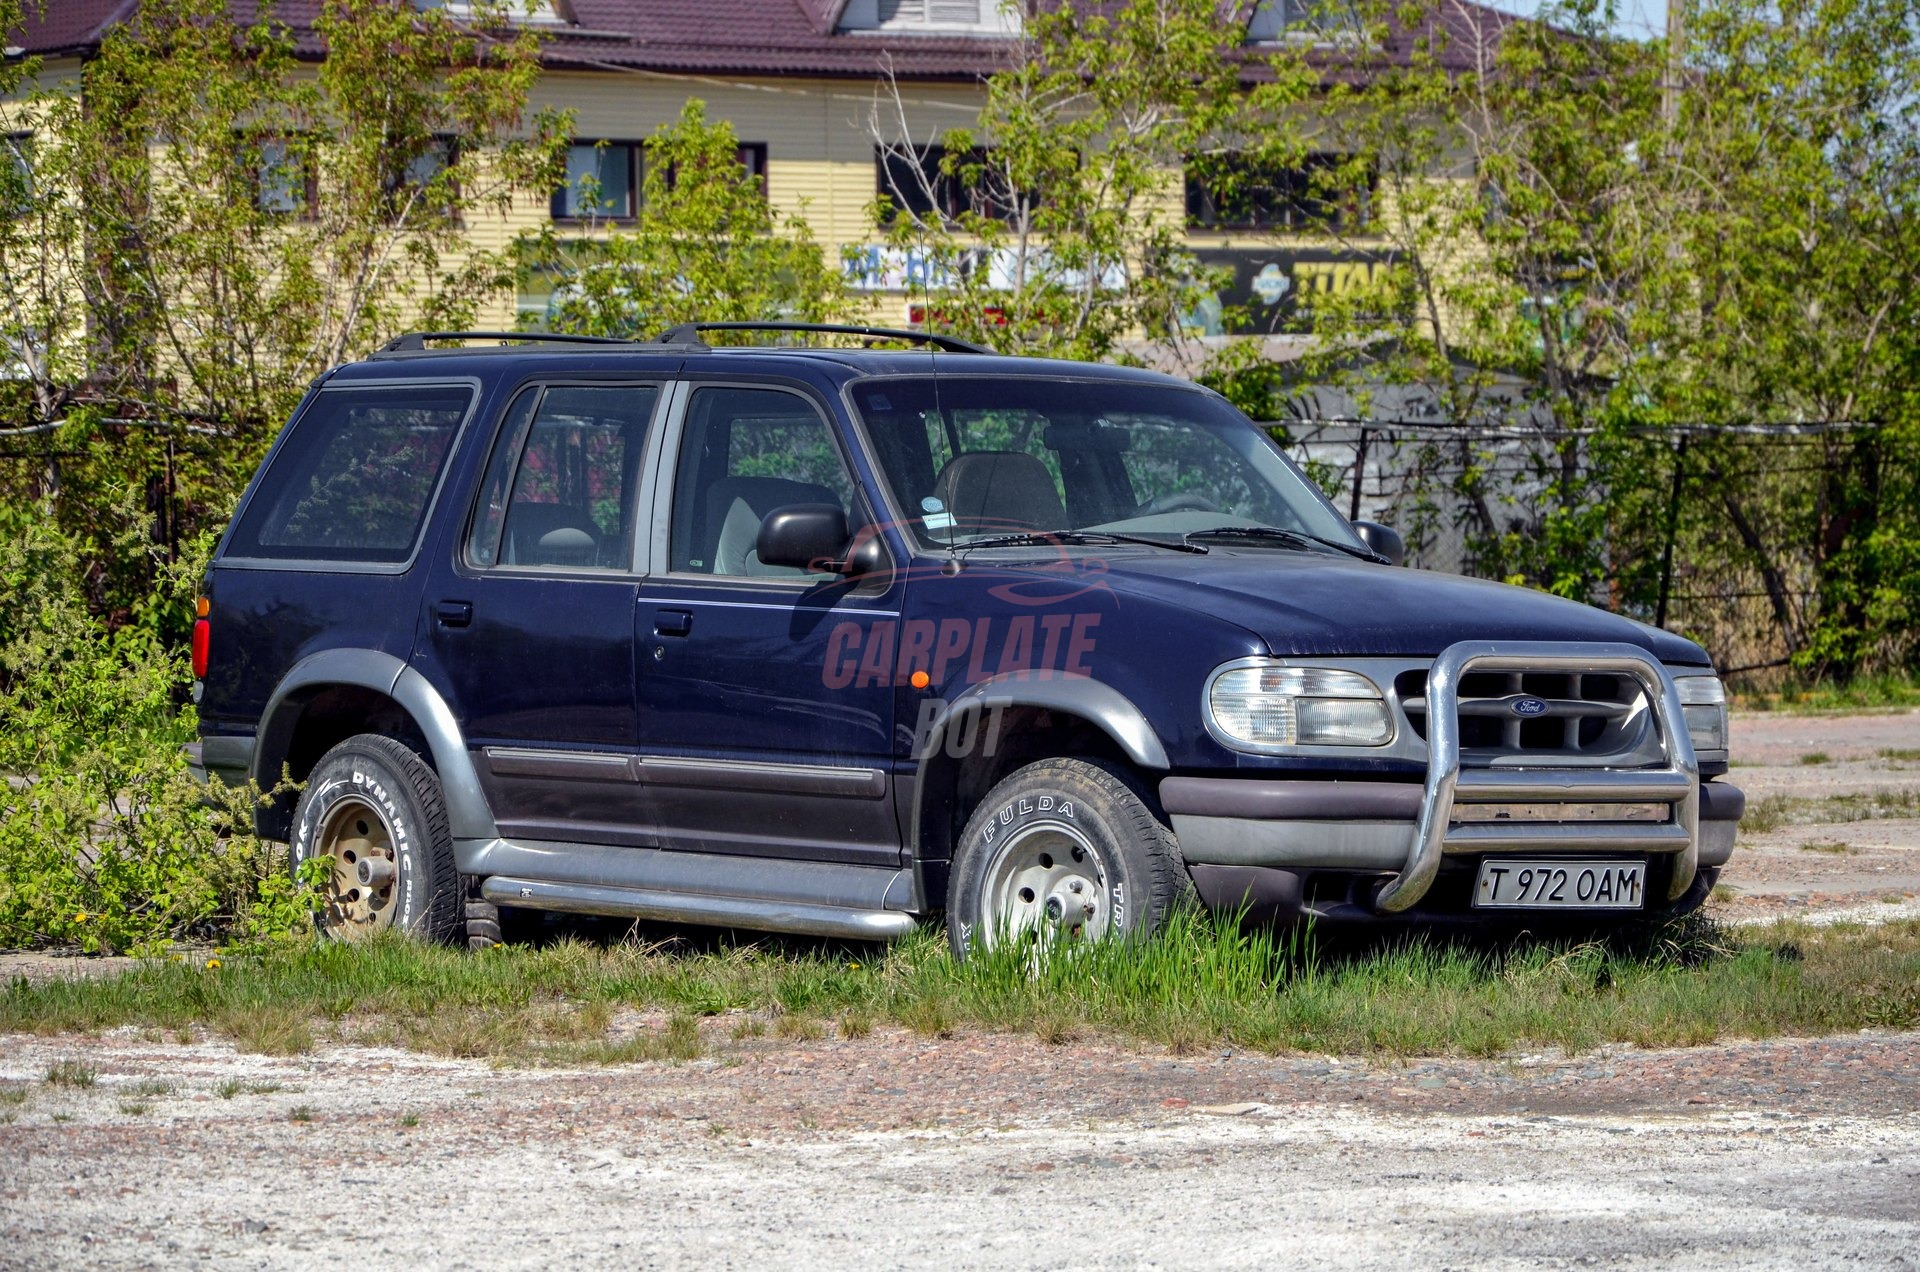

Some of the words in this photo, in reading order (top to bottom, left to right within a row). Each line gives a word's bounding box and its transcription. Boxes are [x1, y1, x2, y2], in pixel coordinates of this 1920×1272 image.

[1519, 699, 1541, 713] Ford
[352, 771, 411, 871] DYNAMIC
[982, 796, 1075, 844] FULDA
[1112, 882, 1124, 933] TR
[1489, 867, 1510, 900] T
[1516, 867, 1568, 901] 972
[1576, 867, 1637, 902] OAM
